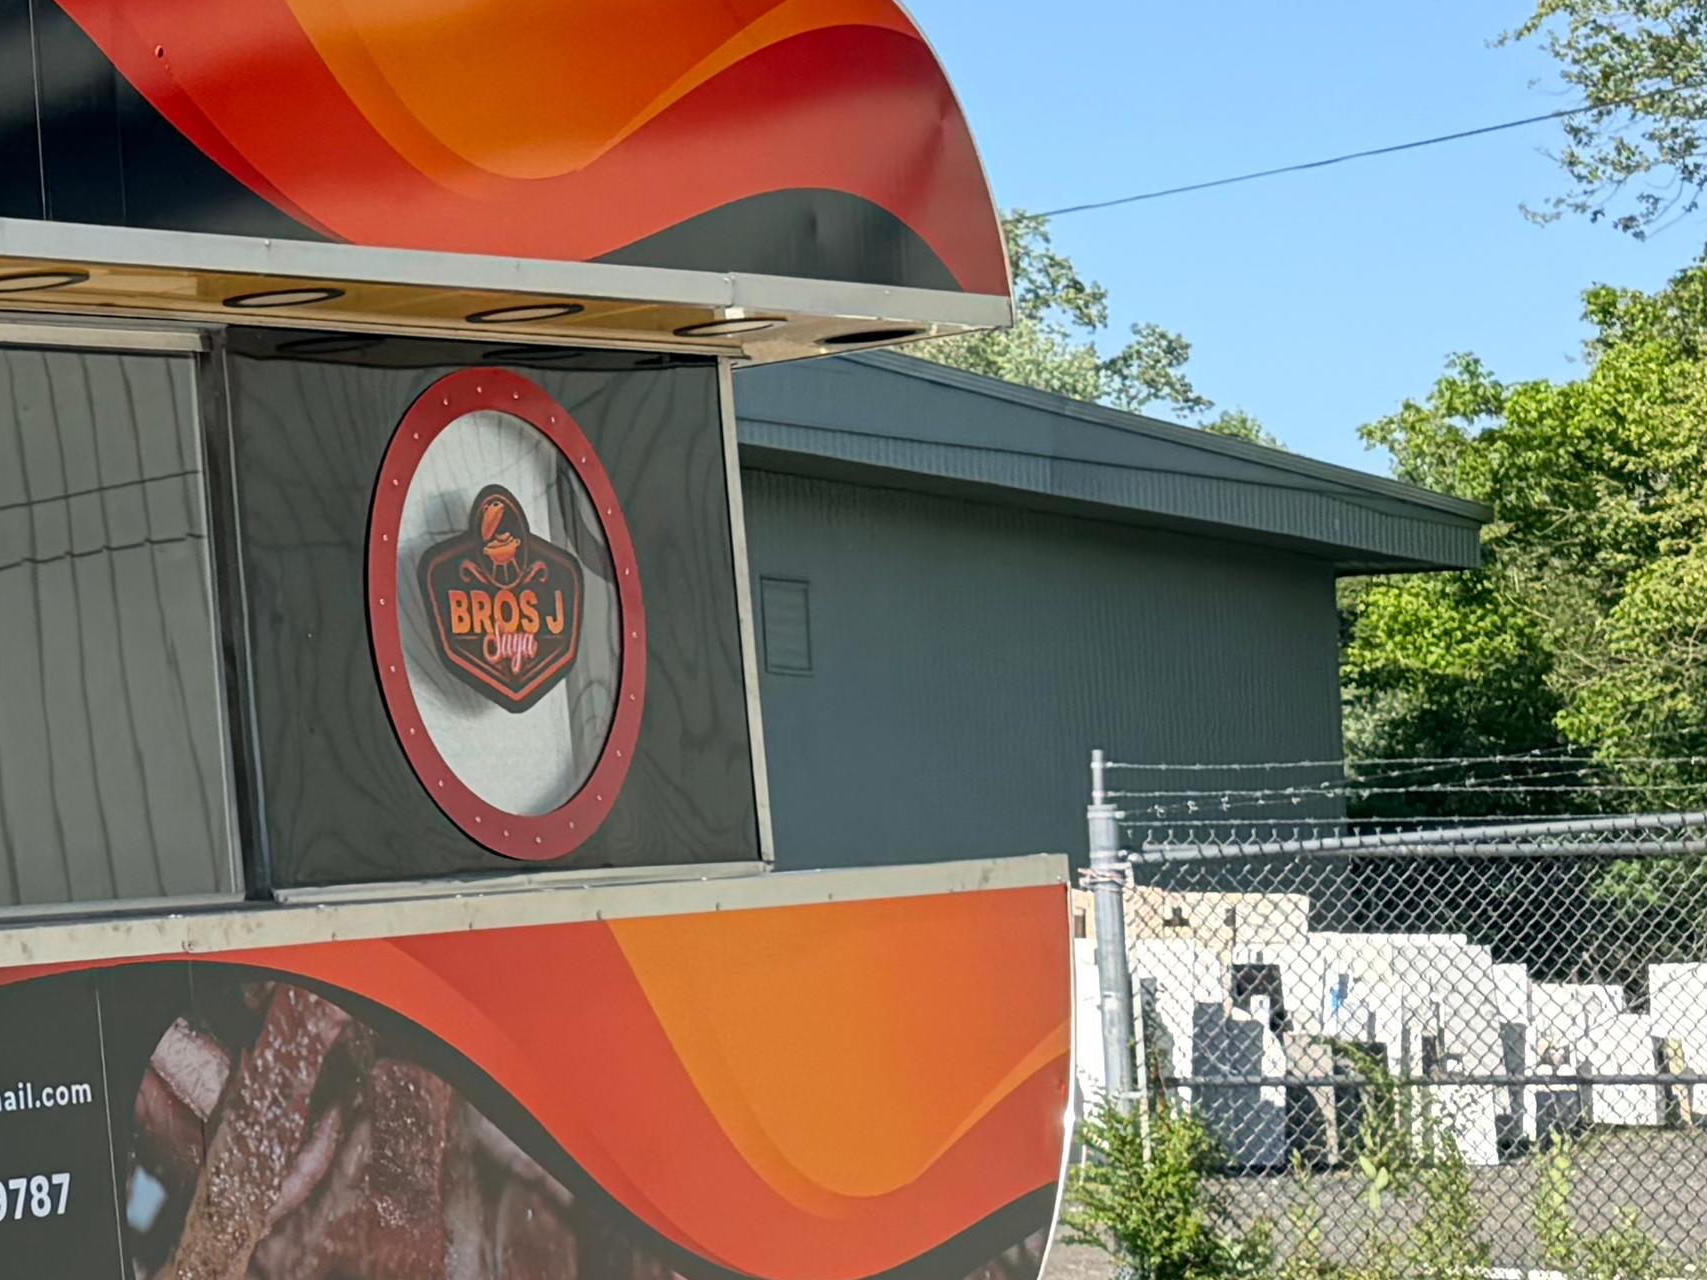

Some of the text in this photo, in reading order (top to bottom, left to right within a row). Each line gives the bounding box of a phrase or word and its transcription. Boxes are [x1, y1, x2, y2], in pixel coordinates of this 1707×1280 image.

[447, 589, 565, 636] BROS J
[482, 624, 539, 674] Suya
